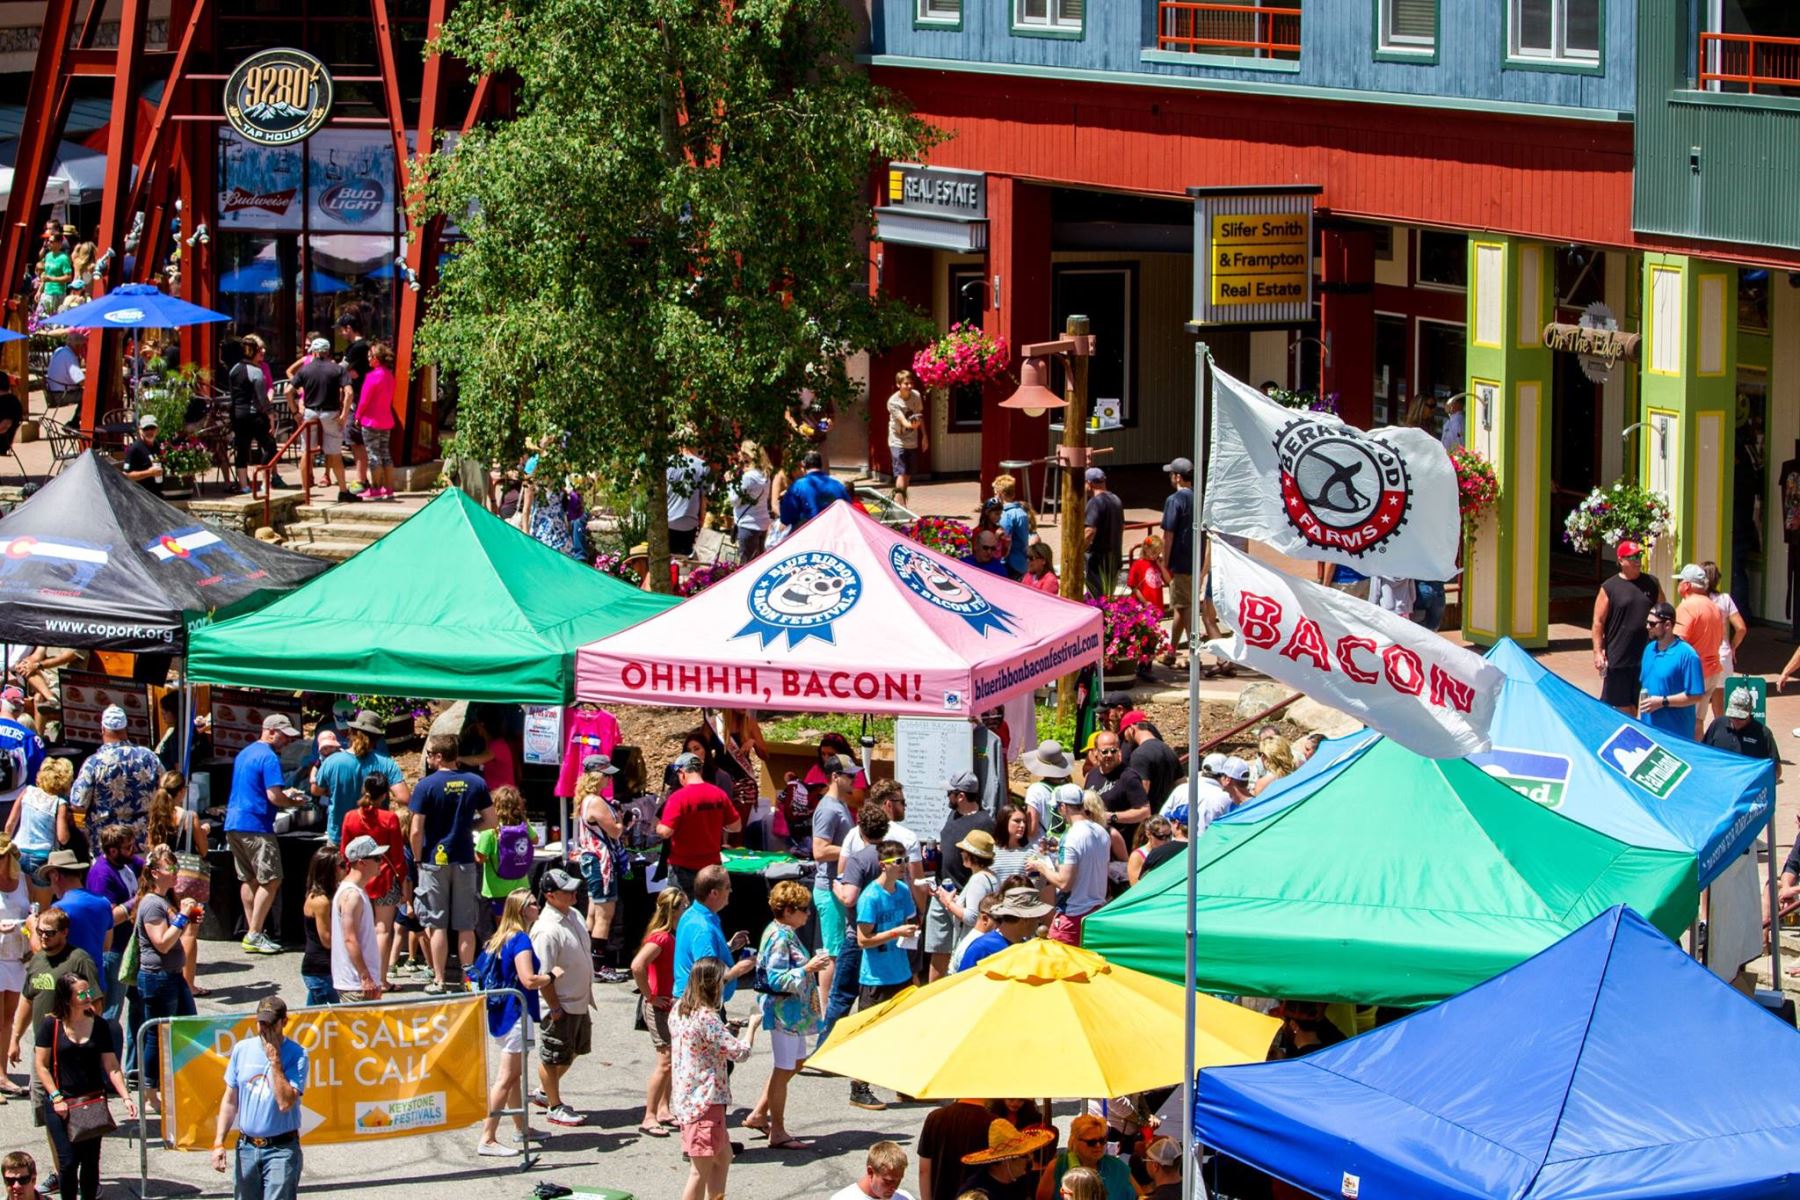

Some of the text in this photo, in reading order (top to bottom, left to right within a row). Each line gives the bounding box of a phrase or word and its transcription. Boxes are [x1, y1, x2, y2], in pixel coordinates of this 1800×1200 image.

[242, 123, 308, 141] TAP HOUSE
[328, 200, 381, 210] LIGHT
[338, 188, 376, 199] BUD
[905, 177, 977, 205] REAL ESTATE
[1221, 221, 1303, 237] Slifer Smith
[1219, 252, 1304, 269] & Frampton
[1221, 282, 1302, 297] Real Estate
[1545, 323, 1563, 350] On
[1567, 328, 1589, 353] The
[1592, 331, 1624, 369] Edge
[1299, 512, 1378, 548] FARMS
[768, 553, 857, 586] BLUE RIBBON
[754, 588, 856, 625] BACON FESTIVAL
[920, 590, 972, 613] BACON
[45, 619, 174, 643] www.copork.org
[1238, 590, 1476, 714] BACON
[975, 633, 1099, 701] blueribbonbaconfestival.com
[621, 662, 922, 703] OHHHH, BACON!
[1634, 749, 1683, 794] Farmland
[293, 1021, 338, 1051] OF
[351, 1014, 450, 1050] SALES
[306, 1053, 431, 1089] ILL CALL
[388, 1095, 435, 1113] KEYSTONE
[394, 1107, 442, 1125] FESTIVALS
